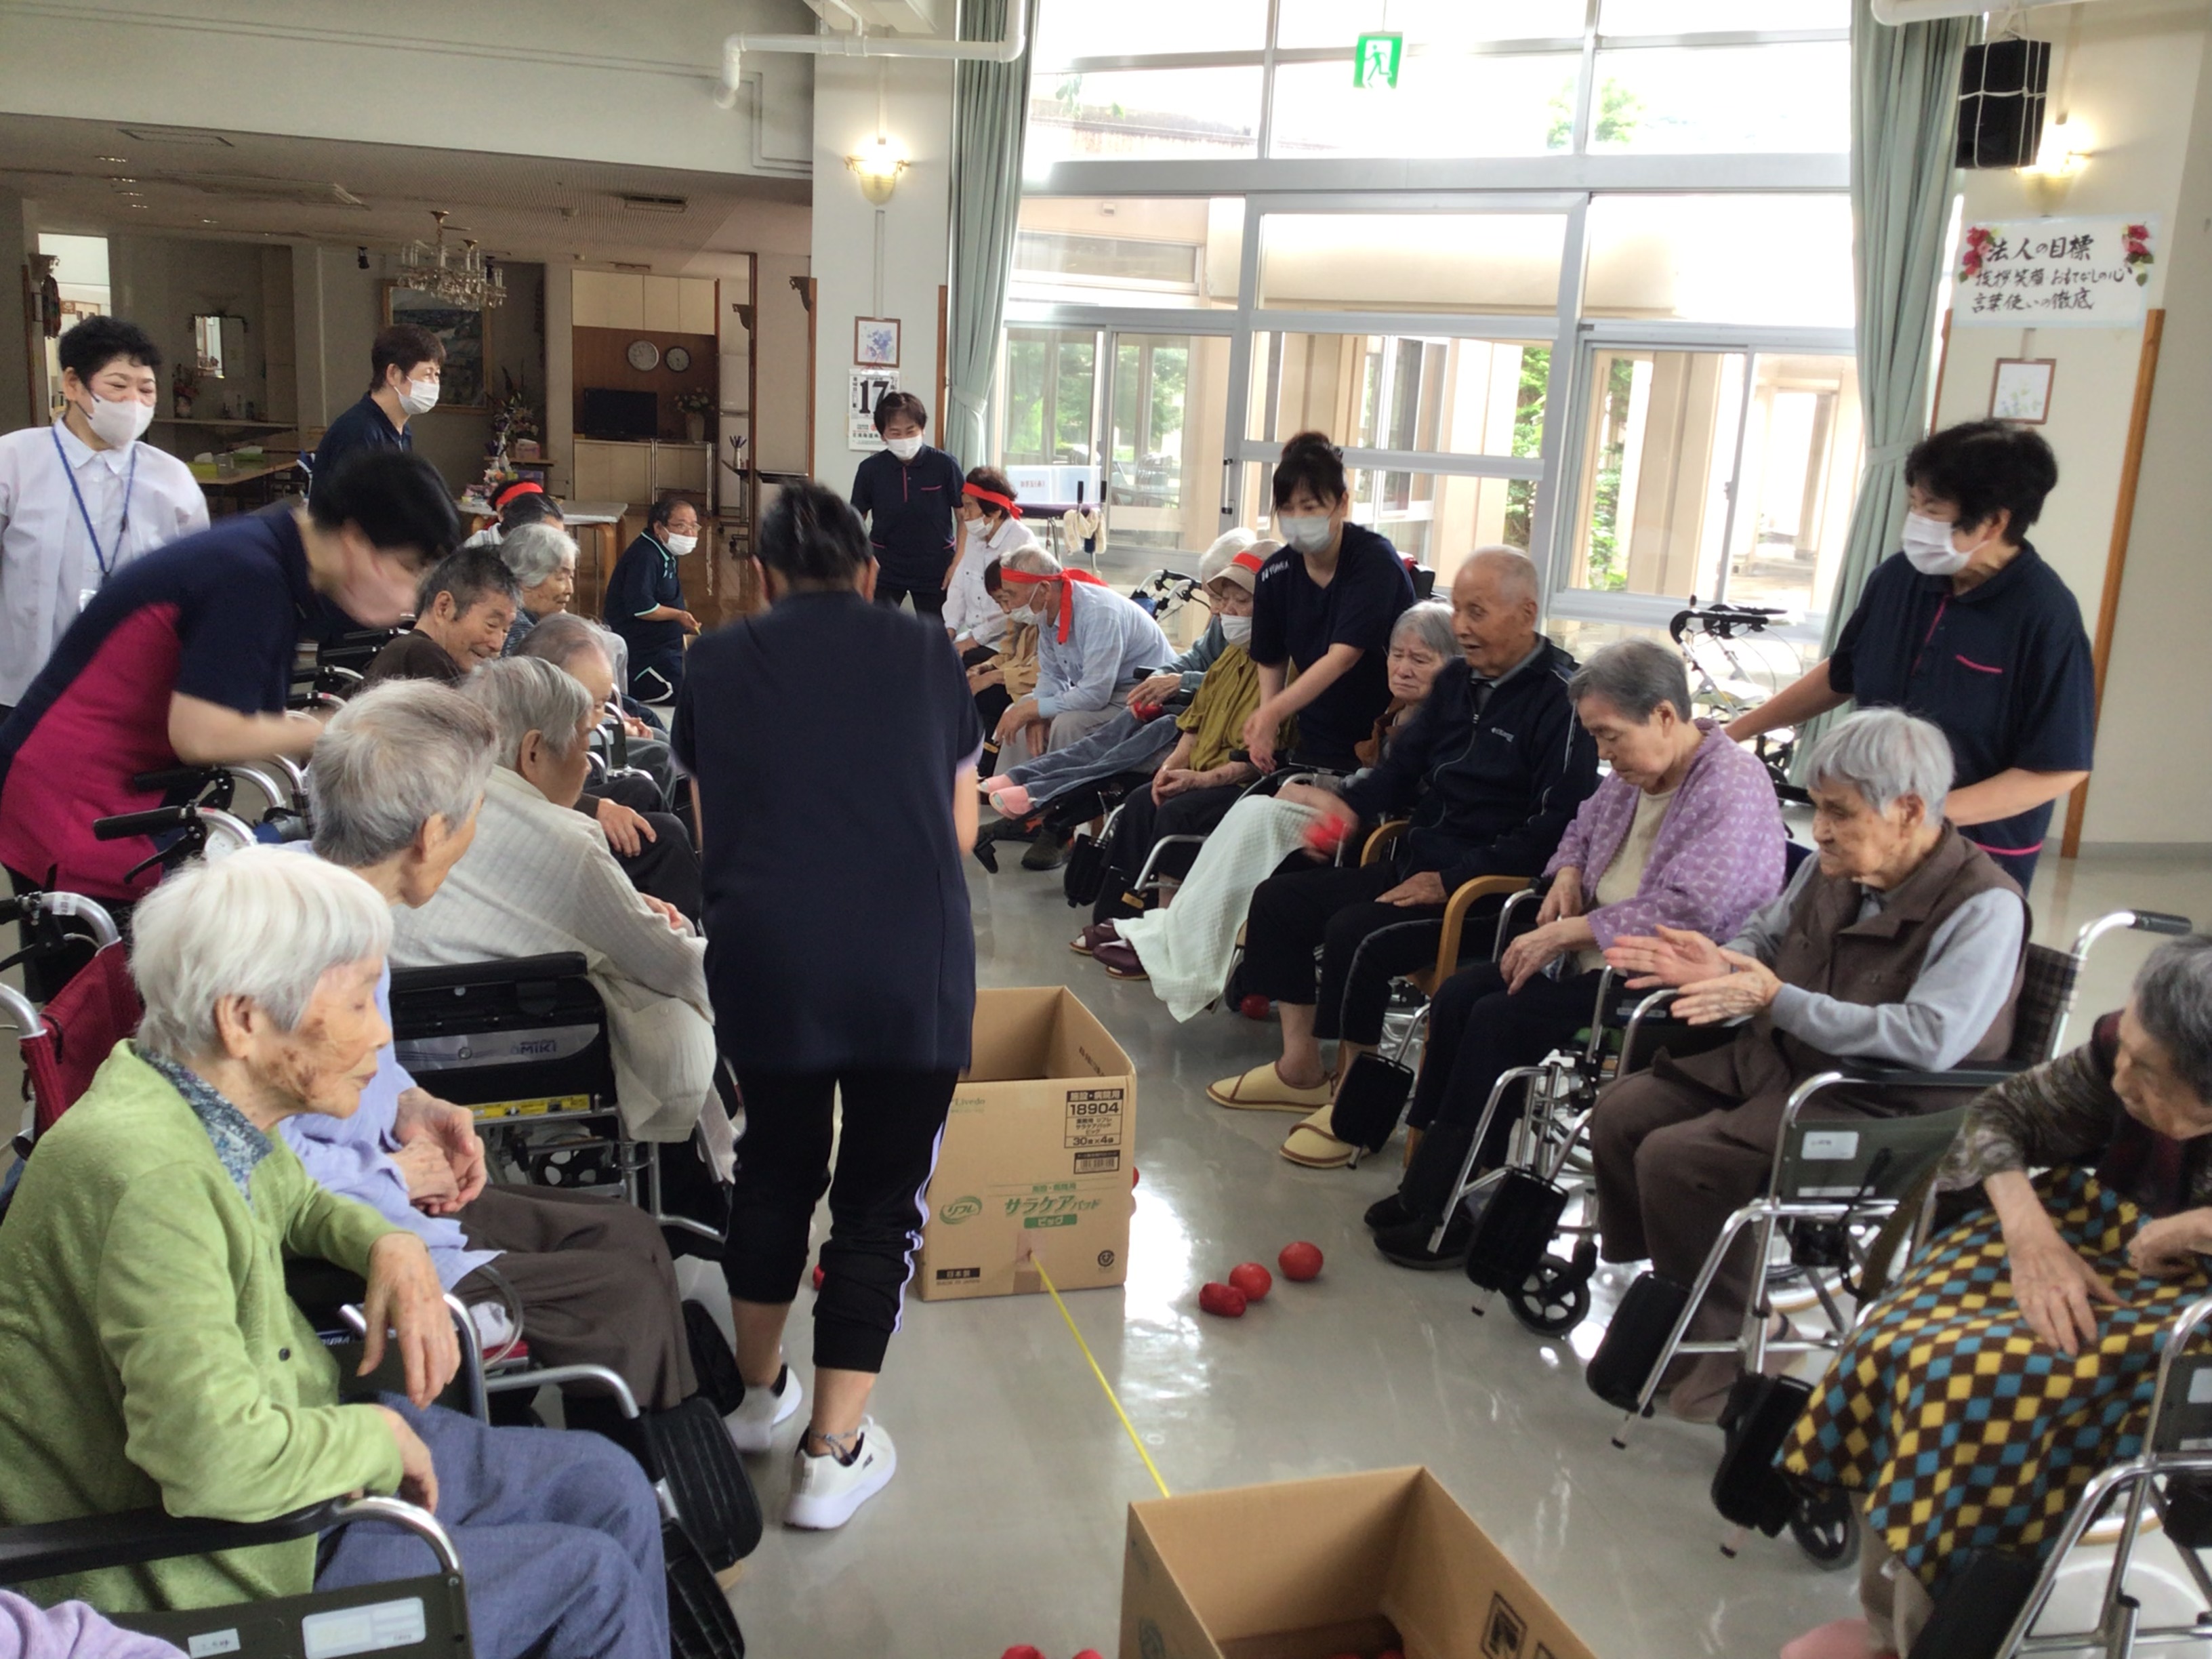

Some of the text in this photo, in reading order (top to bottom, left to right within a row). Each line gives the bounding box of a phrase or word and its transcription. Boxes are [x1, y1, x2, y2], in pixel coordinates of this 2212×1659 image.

[1986, 234, 2094, 263] 法人の目標
[859, 380, 889, 413] 17
[1070, 1102, 1119, 1115] 18904
